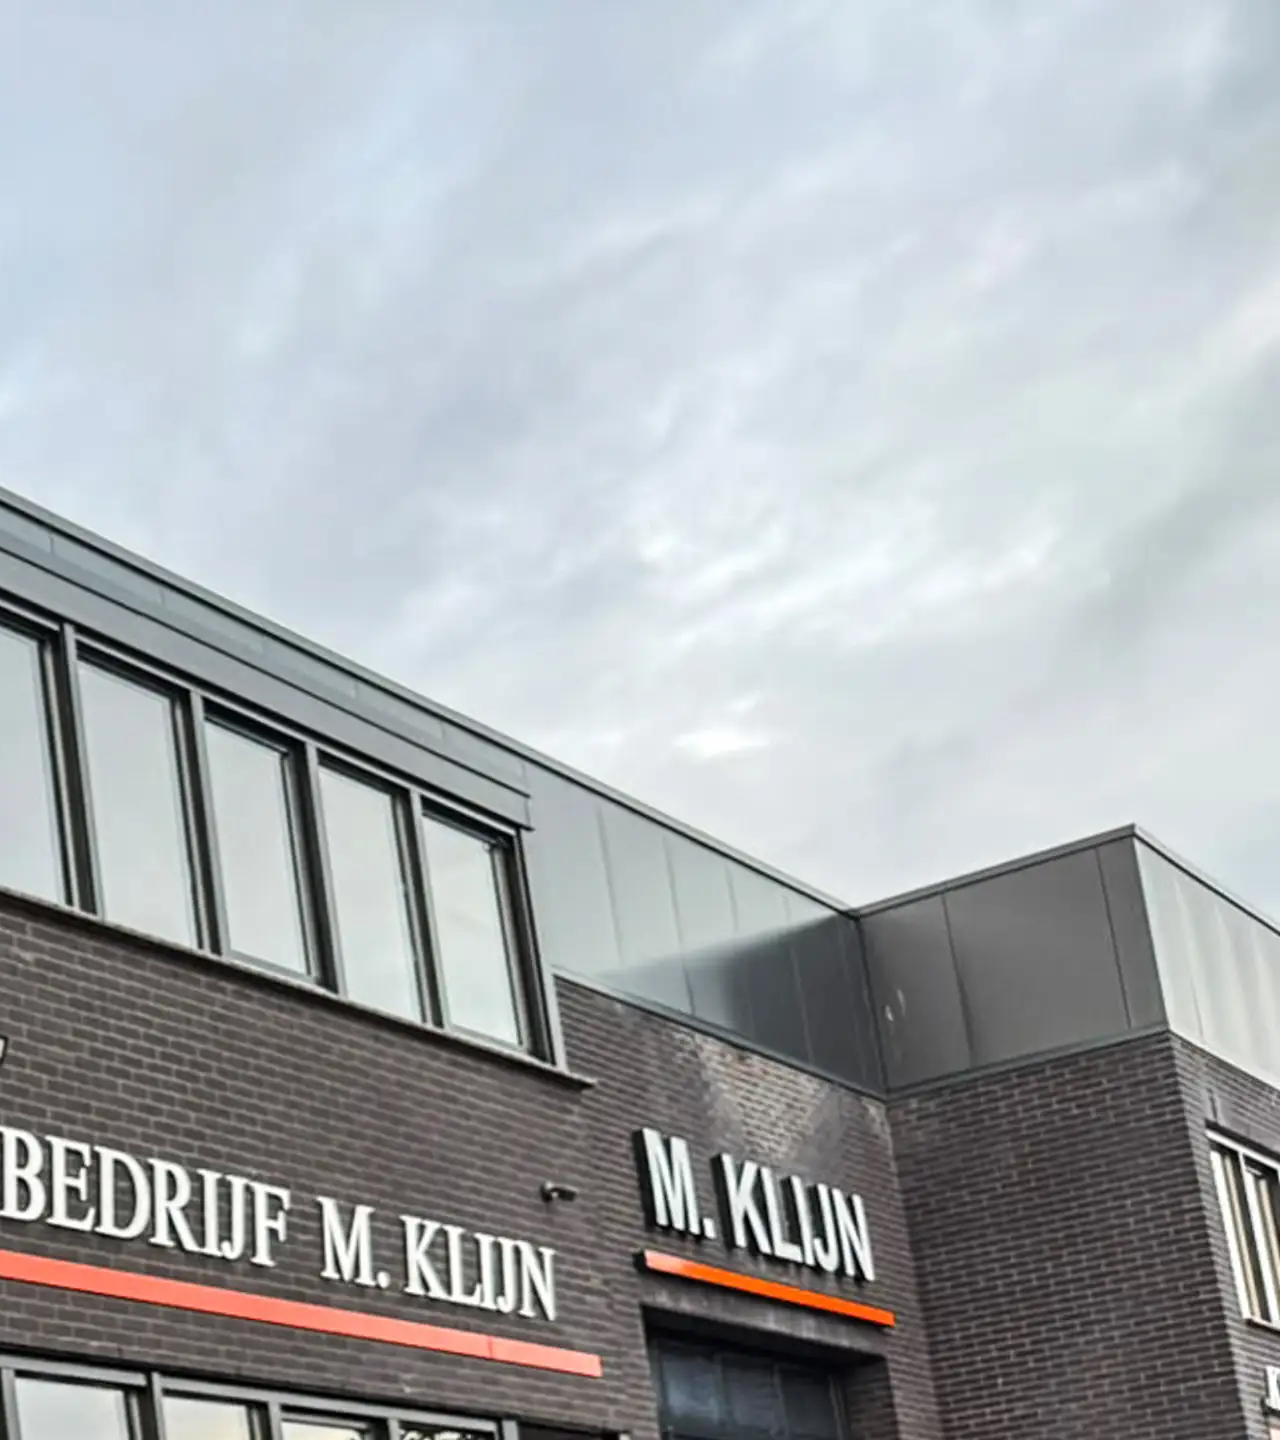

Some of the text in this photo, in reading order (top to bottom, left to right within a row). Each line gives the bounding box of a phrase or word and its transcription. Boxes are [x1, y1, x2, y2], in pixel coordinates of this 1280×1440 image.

[317, 1196, 389, 1289] M.
[399, 1214, 557, 1321] KLIJN
[641, 1127, 875, 1282] M. KLIJN
